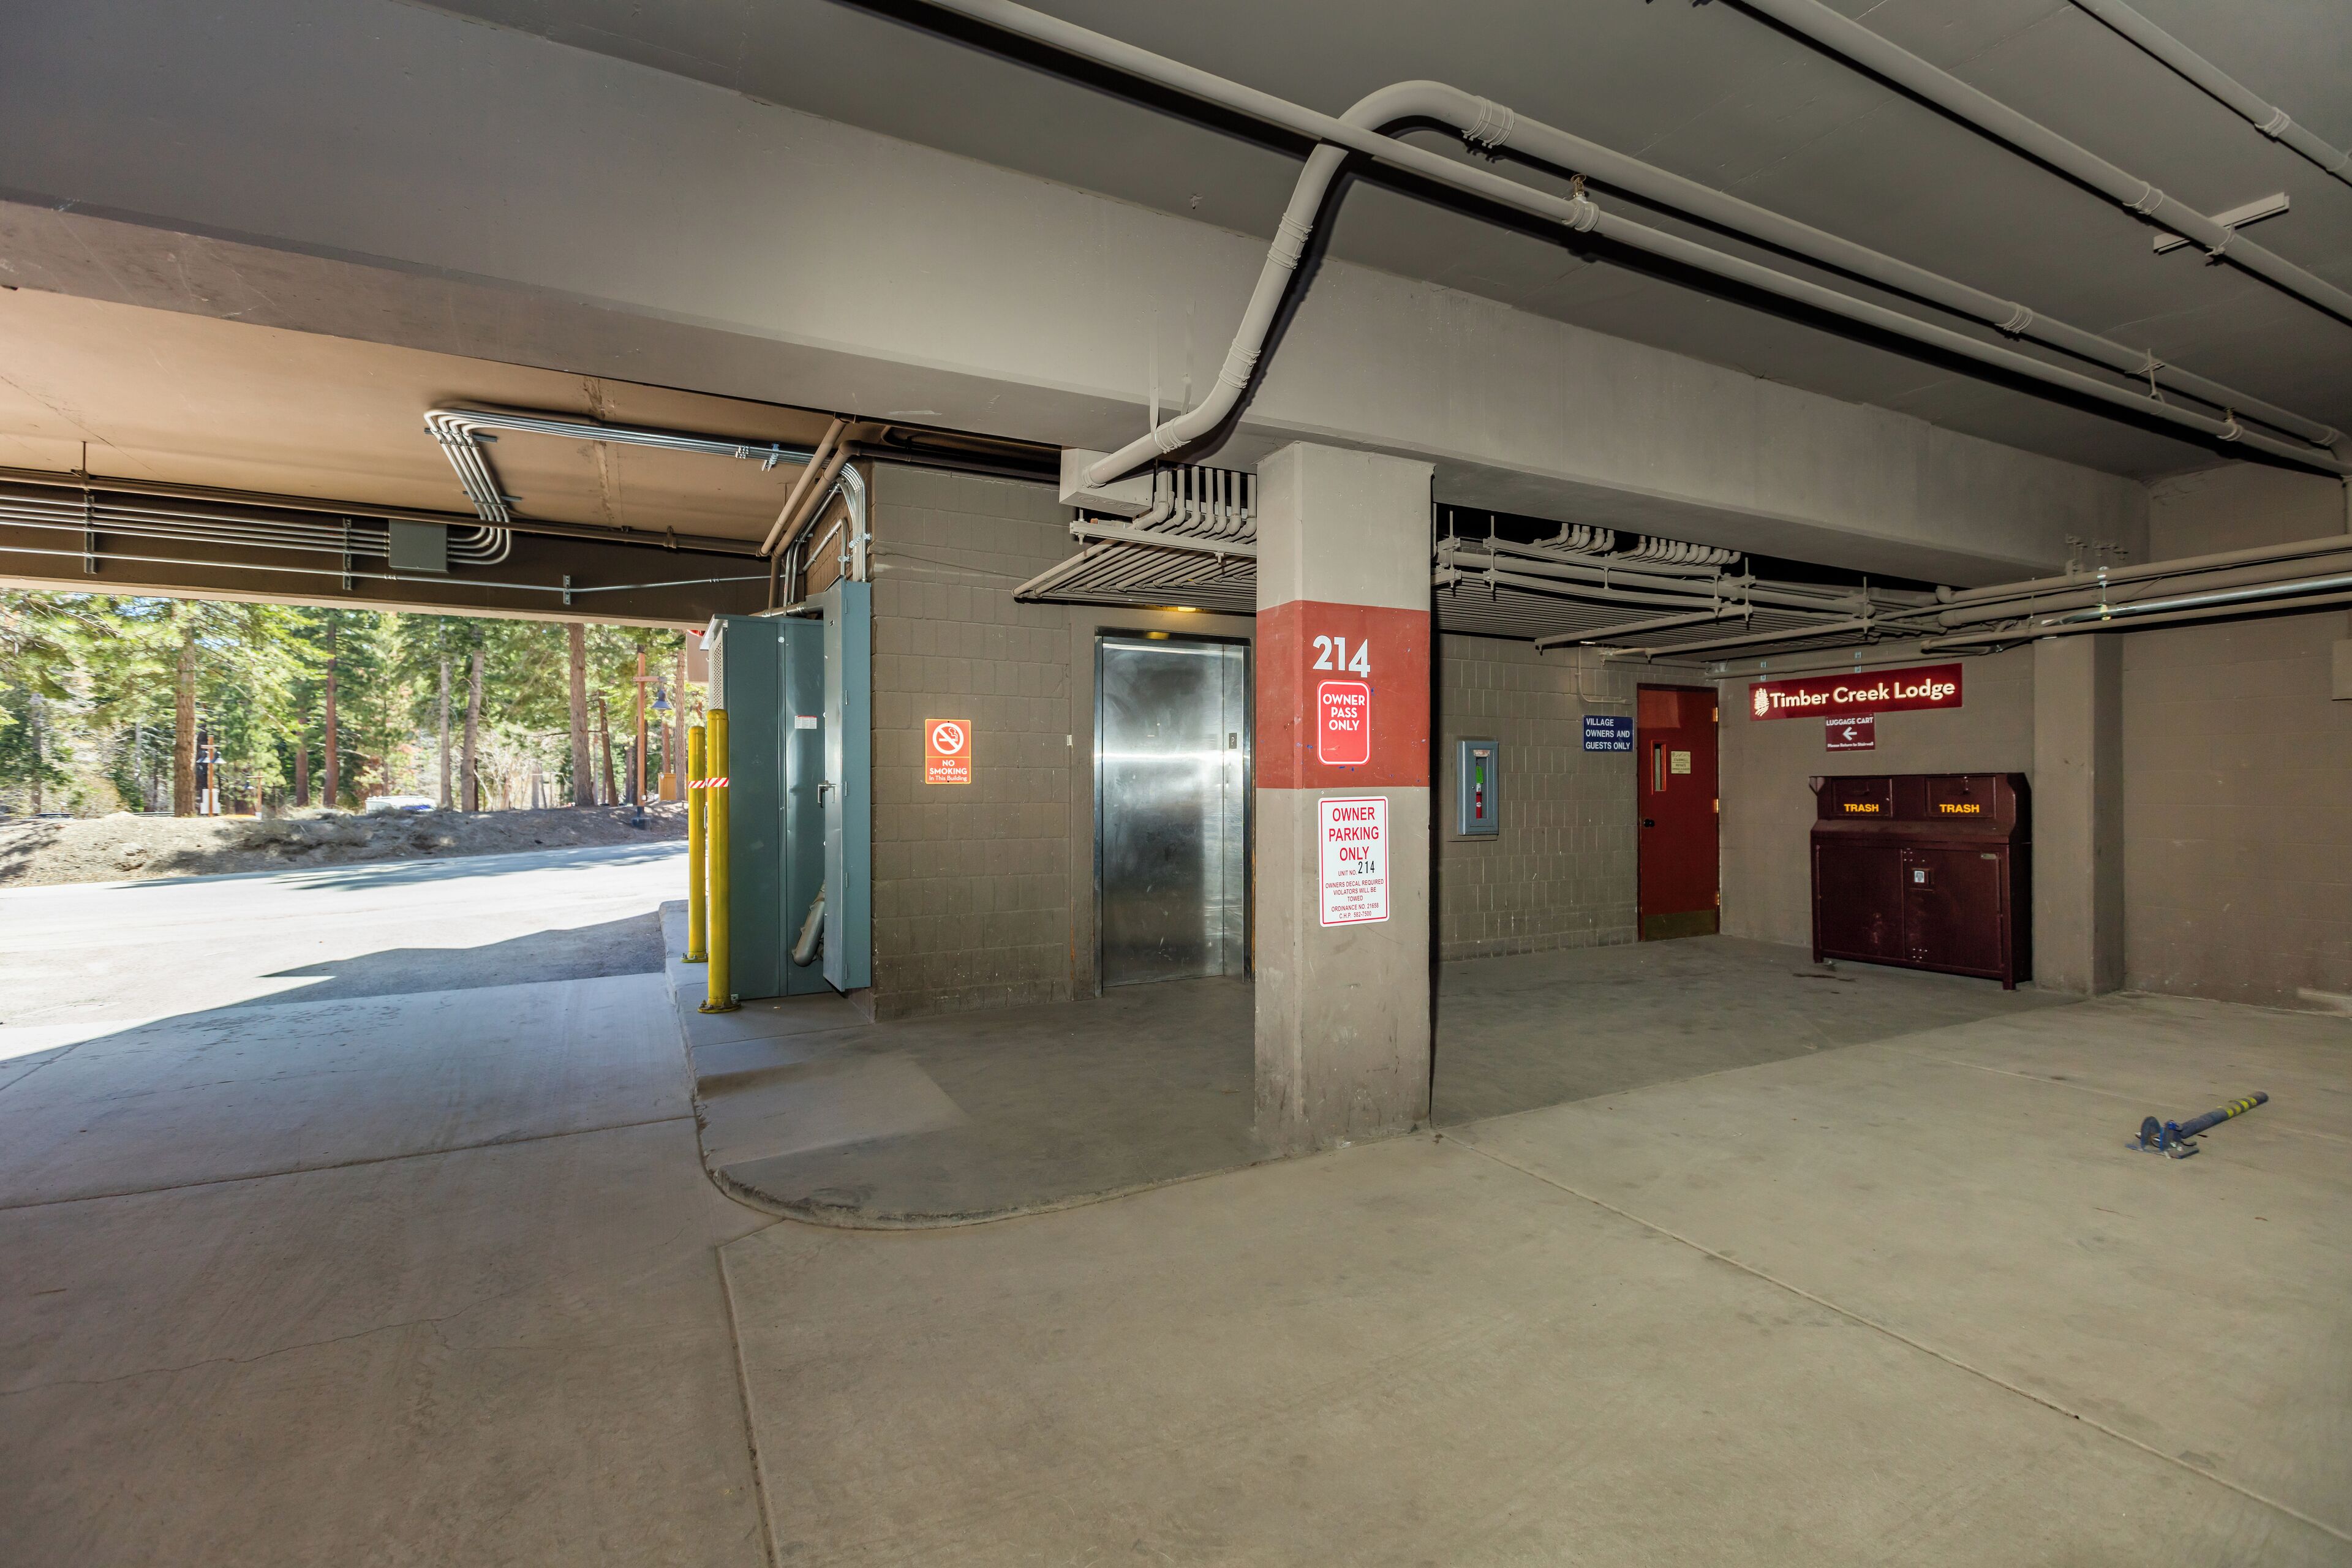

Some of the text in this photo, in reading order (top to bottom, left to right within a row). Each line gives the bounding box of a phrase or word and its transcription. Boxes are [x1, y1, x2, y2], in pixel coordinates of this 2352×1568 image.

[1313, 635, 1371, 677] 214
[1770, 678, 1955, 708] Timber Creek Lodge
[1322, 693, 1365, 706] OWNER
[1331, 707, 1358, 718] PASS
[1329, 719, 1360, 731] ONLY
[1586, 718, 1615, 726] VILLAGE
[1826, 718, 1856, 726] LUGGAGE
[1586, 729, 1615, 738] OWNERS
[1585, 741, 1612, 750] GUESTS
[1844, 804, 1879, 812] TRASH
[1939, 804, 1980, 813] TRASH
[1332, 807, 1376, 822] OWNER
[1329, 826, 1379, 842] PARKING
[1340, 846, 1370, 861] ONLY
[1358, 861, 1375, 874] 214
